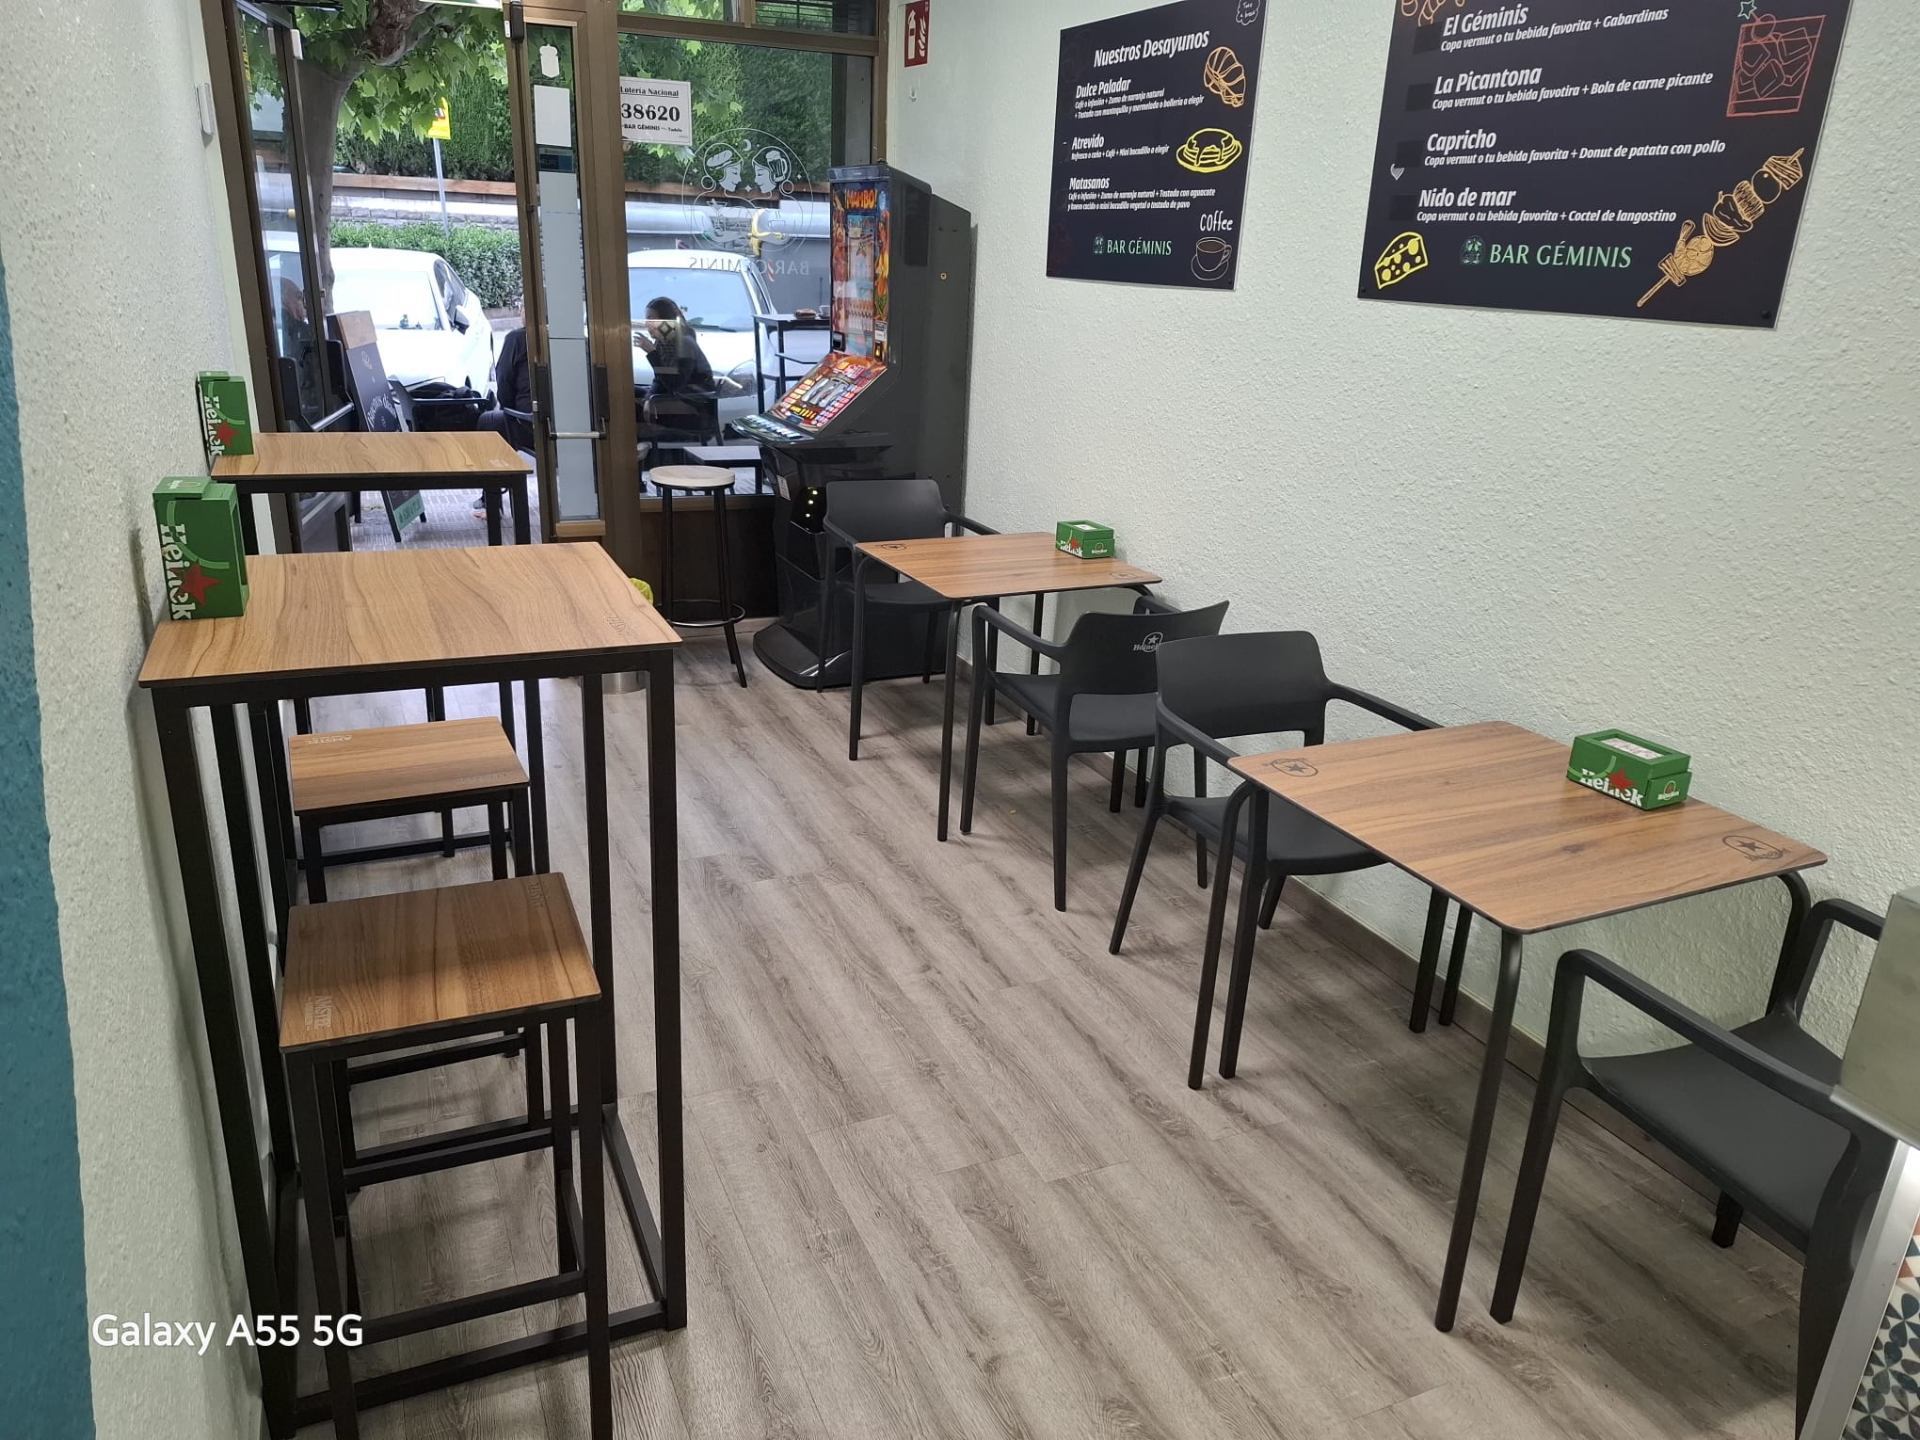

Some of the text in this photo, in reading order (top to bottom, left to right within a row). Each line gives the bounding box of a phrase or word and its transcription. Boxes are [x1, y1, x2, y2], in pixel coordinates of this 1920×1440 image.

[1441, 38, 1462, 53] Copa
[1463, 35, 1495, 48] vermut
[1496, 34, 1502, 43] o
[1504, 31, 1514, 42] tu
[1515, 25, 1549, 41] bebida
[1549, 18, 1591, 38] favorita
[1602, 8, 1669, 29] Gabardinas
[1443, 3, 1529, 37] El Géminis
[1094, 30, 1210, 68] Nuestros Desayunos
[1075, 77, 1131, 98] Dulce Paladar
[1434, 66, 1542, 95] La Picantona
[648, 88, 679, 97] Nacional
[1432, 98, 1453, 111] Copa
[1454, 95, 1486, 108] vermut
[1487, 95, 1493, 104] o
[1494, 92, 1504, 103] tu
[1505, 87, 1538, 103] bebida
[1538, 83, 1579, 102] favotira
[1590, 82, 1614, 95] Bola
[1616, 79, 1630, 92] de
[1632, 77, 1666, 91] carne
[1666, 72, 1713, 91] picante
[621, 103, 680, 122] 38620
[1071, 133, 1105, 150] Atrevido
[1427, 128, 1497, 155] Capricho
[1424, 156, 1445, 168] Copa
[1446, 154, 1476, 166] vermut
[1477, 155, 1484, 164] o
[1485, 153, 1495, 163] tu
[1496, 150, 1527, 163] bebida
[1527, 148, 1569, 164] favorita
[1579, 147, 1614, 159] Donut
[1614, 145, 1628, 157] de
[1628, 144, 1669, 159] patata
[1670, 144, 1692, 155] con
[1692, 140, 1726, 157] pollo
[1069, 177, 1110, 190] Matasanos
[1176, 201, 1191, 210] pavo
[1418, 187, 1517, 207] Nido de mar
[1416, 211, 1437, 223] Copa
[1438, 211, 1468, 222] vermut
[1469, 213, 1475, 221] o
[1476, 211, 1487, 222] tu
[1487, 210, 1519, 222] bebida
[1518, 210, 1558, 224] favorita
[1568, 210, 1601, 222] Coctel
[1601, 210, 1615, 222] de
[1616, 209, 1677, 225] langostino
[1107, 236, 1172, 256] BAR GÉMINIS
[1489, 240, 1632, 269] BAR GÉMINIS
